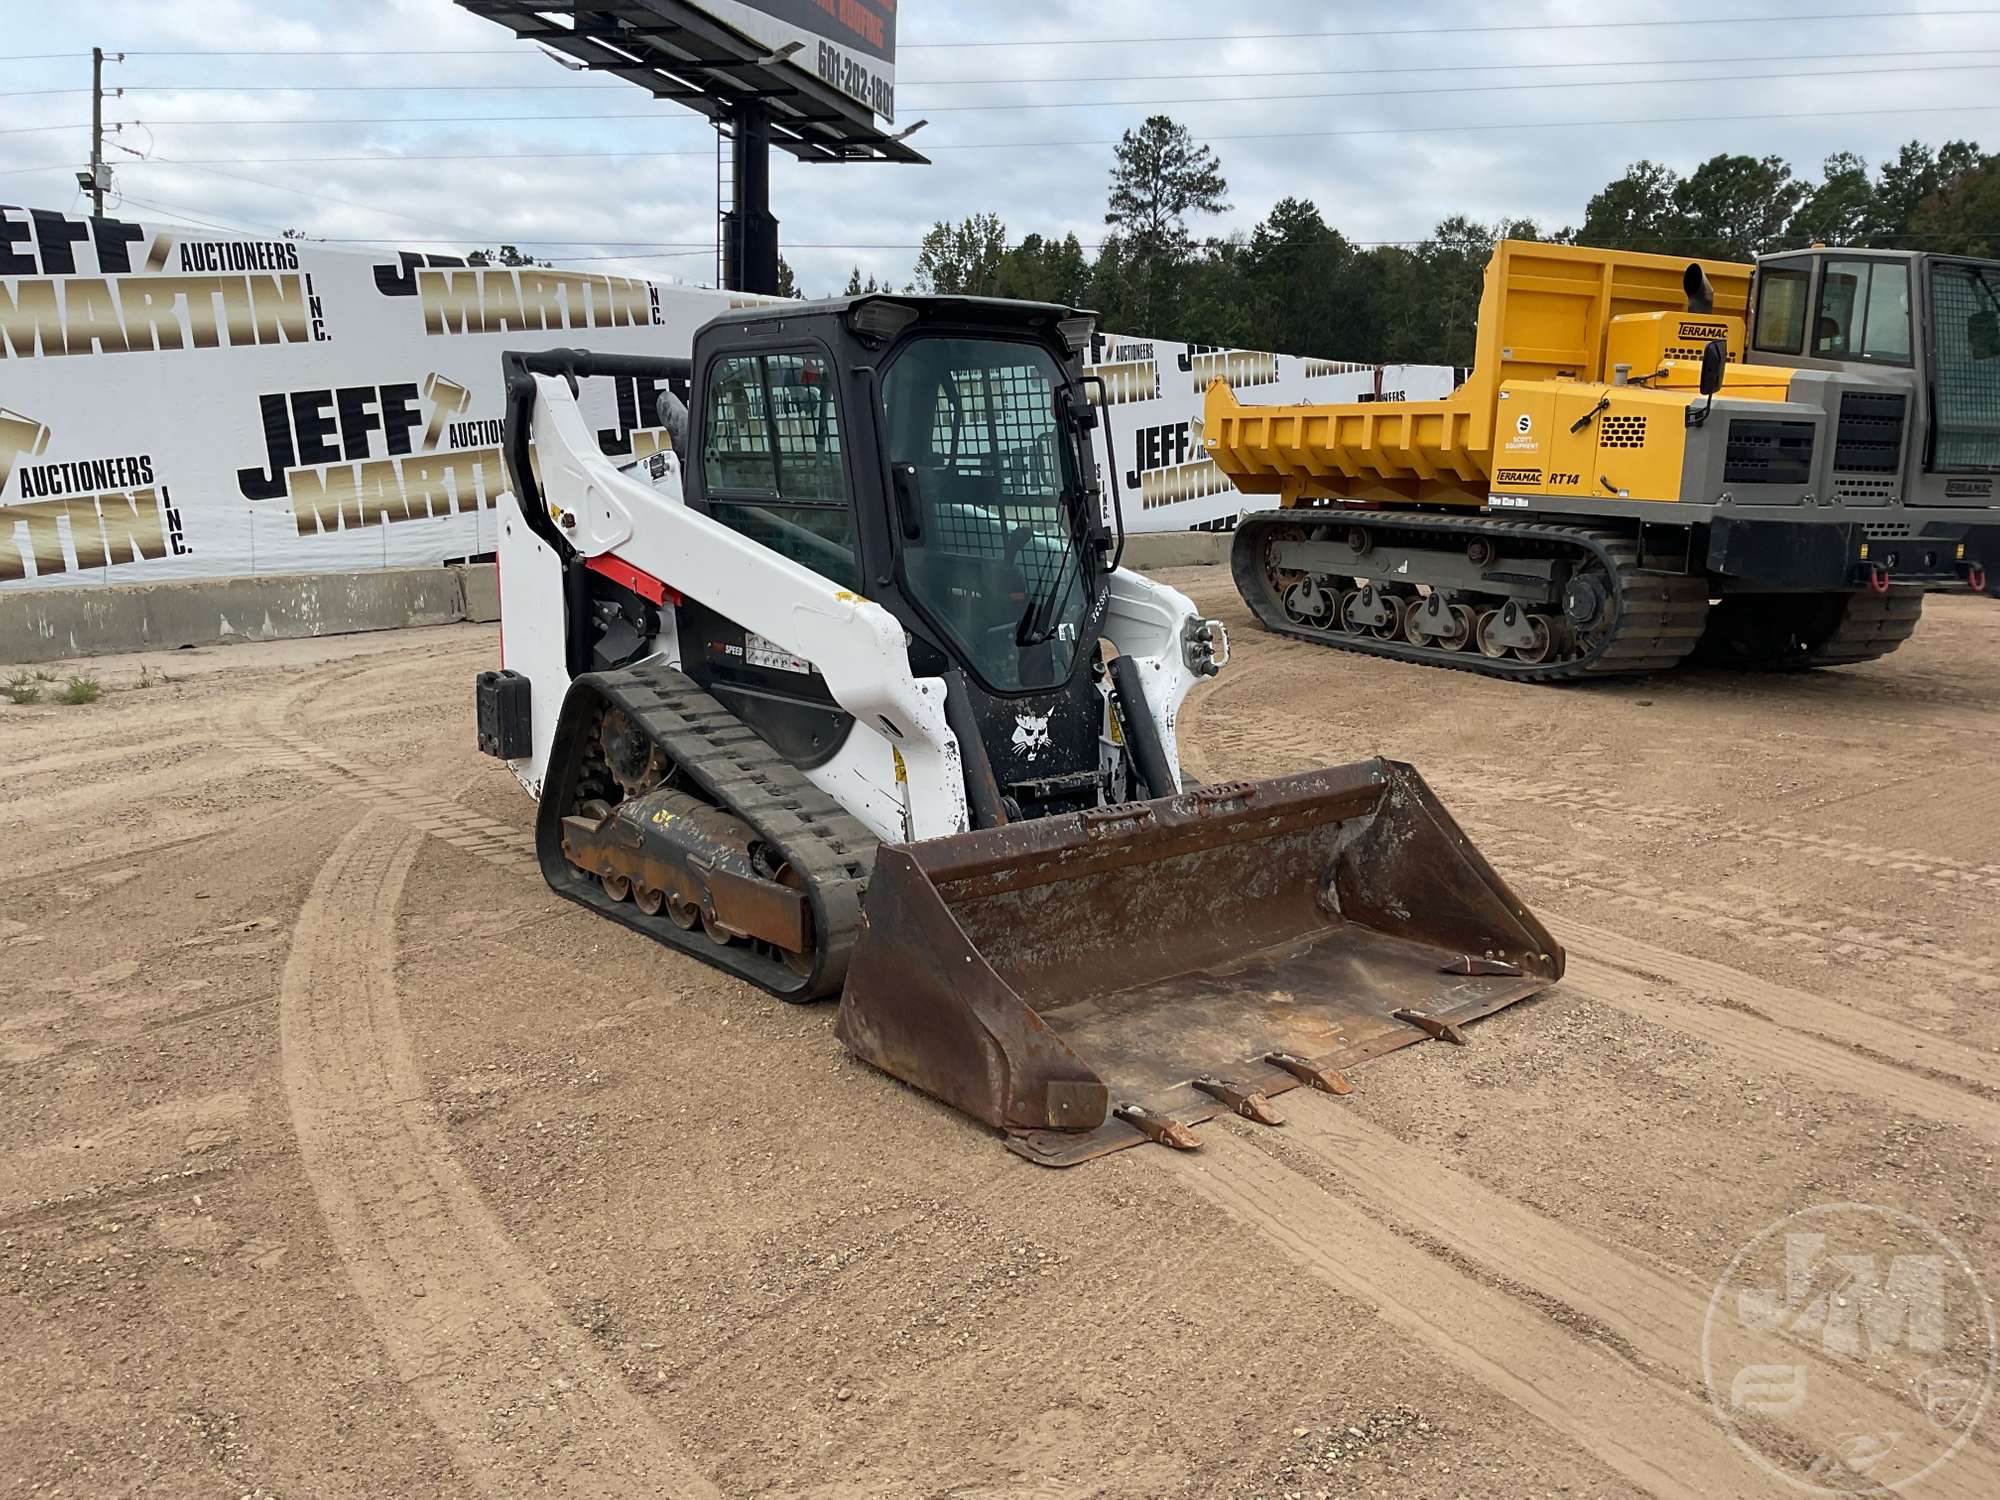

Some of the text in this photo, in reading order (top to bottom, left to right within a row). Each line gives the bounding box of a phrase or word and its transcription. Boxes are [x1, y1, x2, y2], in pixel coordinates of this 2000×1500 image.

[180, 242, 299, 272] AUCTIONEERS
[418, 270, 650, 336] MARTIN
[237, 383, 423, 501] JEFF
[1126, 422, 1189, 489] JEFF
[19, 455, 154, 498] AUCTIONEERS
[1549, 473, 1580, 485] RT14
